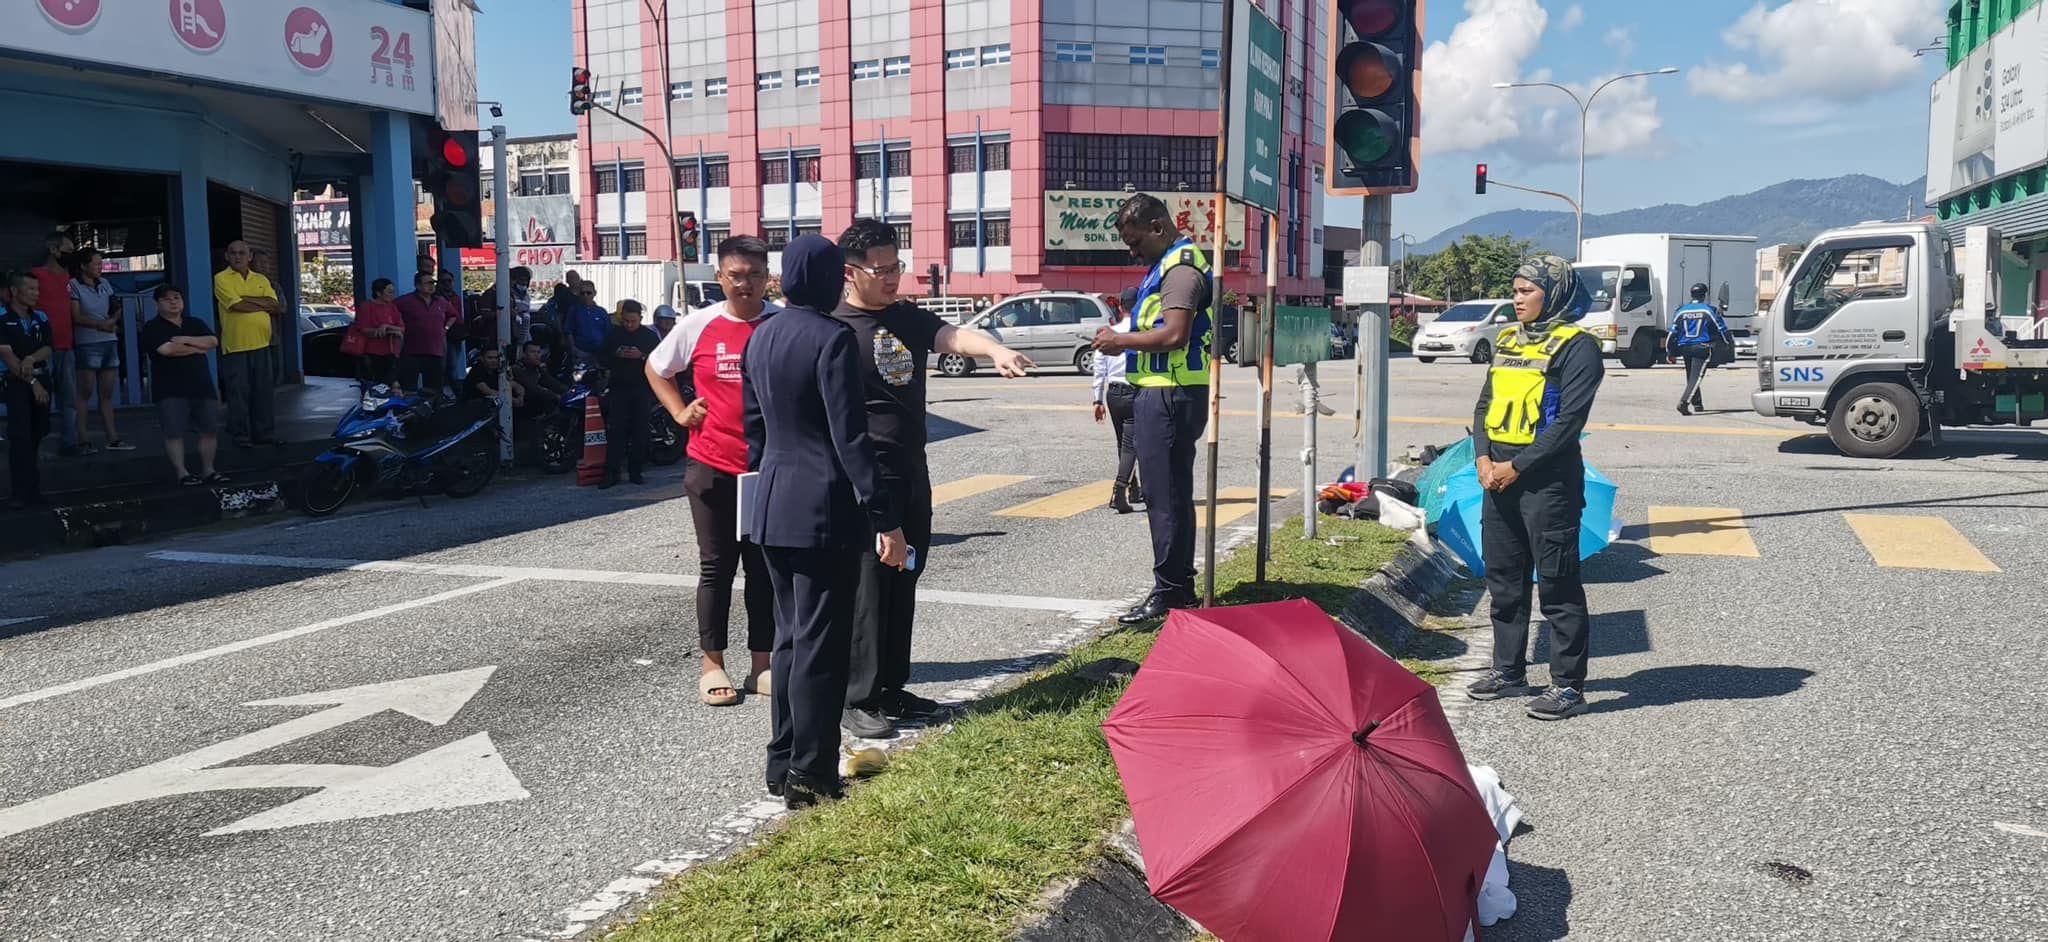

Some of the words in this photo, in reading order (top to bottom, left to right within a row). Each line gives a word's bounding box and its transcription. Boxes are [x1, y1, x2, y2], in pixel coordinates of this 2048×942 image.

[370, 26, 413, 68] 24
[2002, 64, 2022, 86] Galaxy
[1084, 234, 1107, 242] SDN.
[517, 248, 563, 265] CHOY
[1780, 367, 1824, 382] SNS
